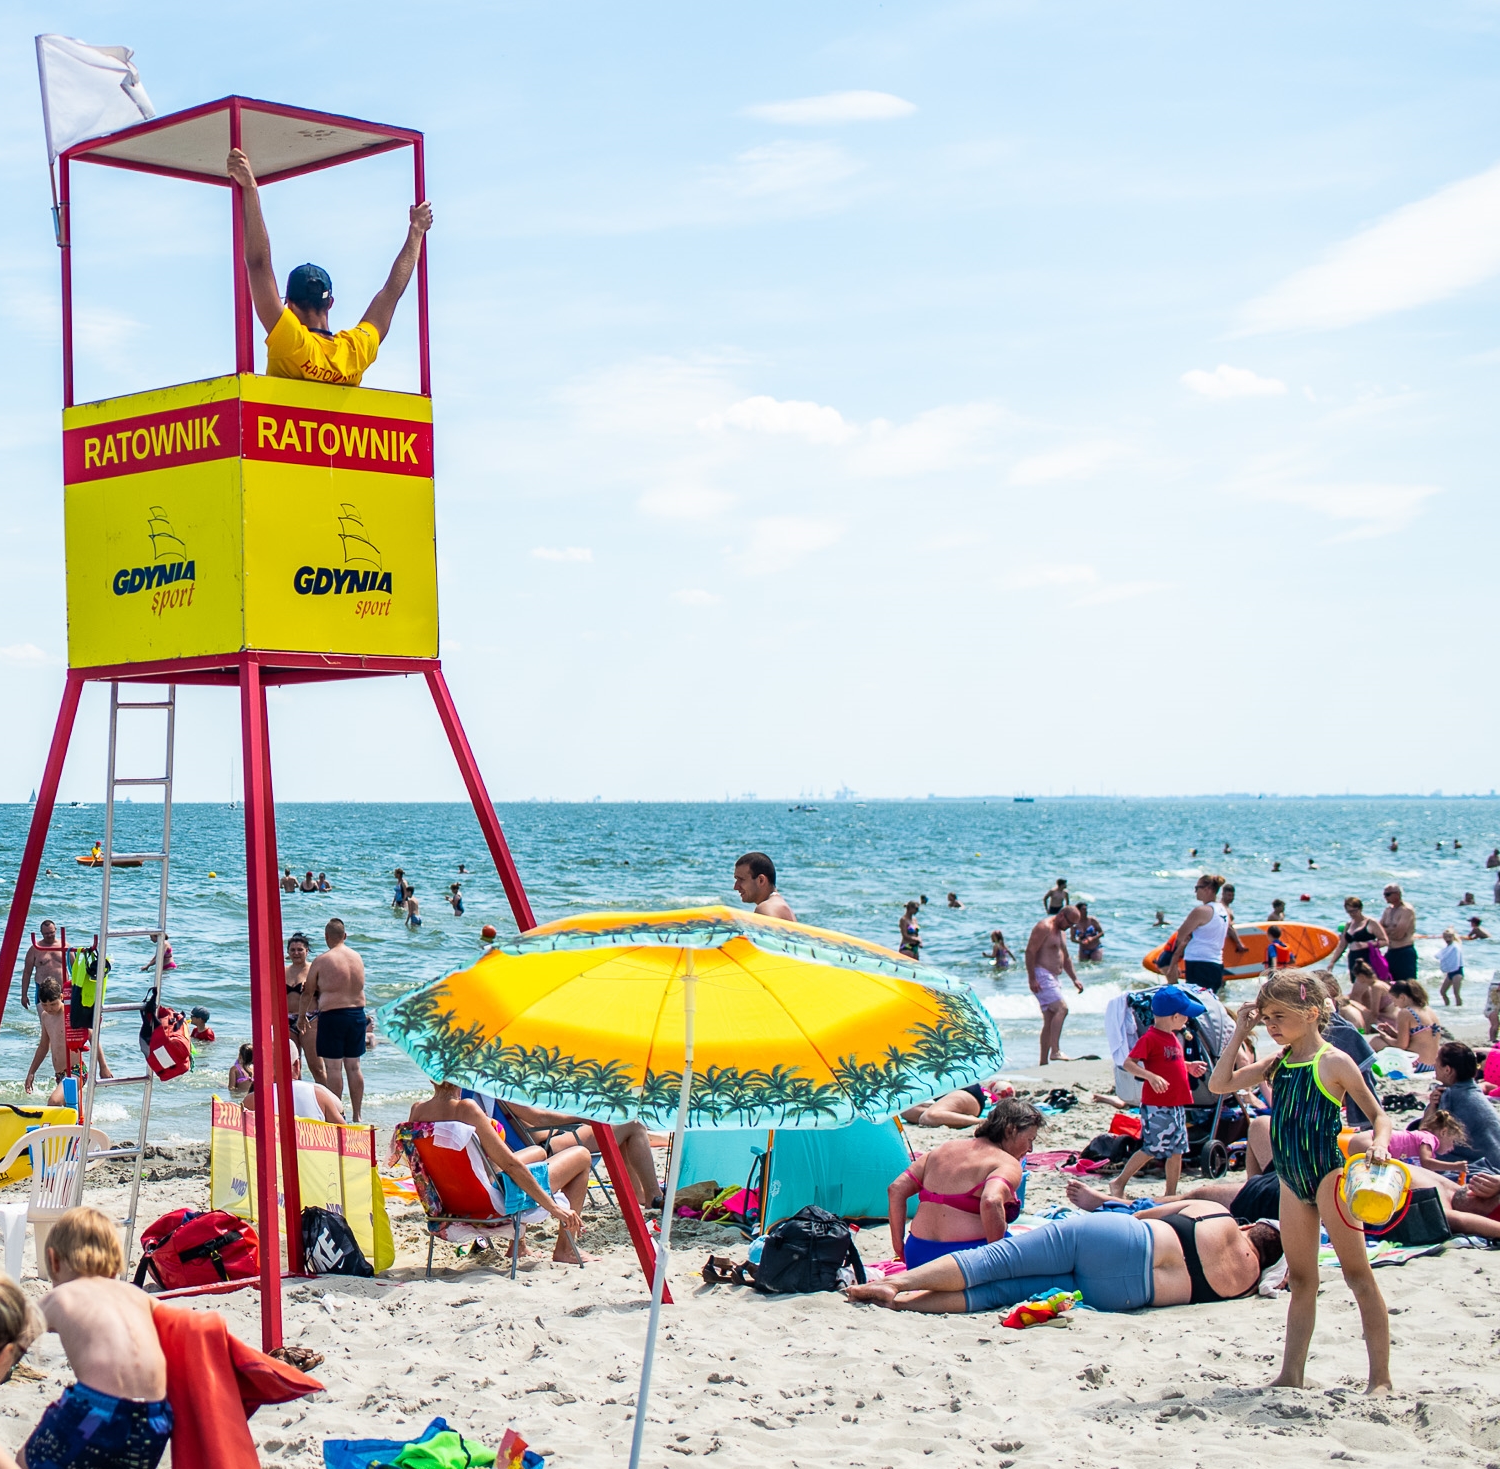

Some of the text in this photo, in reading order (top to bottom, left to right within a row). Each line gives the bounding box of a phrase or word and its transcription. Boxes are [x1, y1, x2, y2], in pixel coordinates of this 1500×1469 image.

[85, 414, 221, 469] RATOWNIK
[257, 416, 419, 465] RATOWNIK
[113, 560, 195, 596] GDYNIA
[293, 566, 392, 595] GDYNIA
[151, 582, 195, 617] sport
[355, 599, 392, 619] sport
